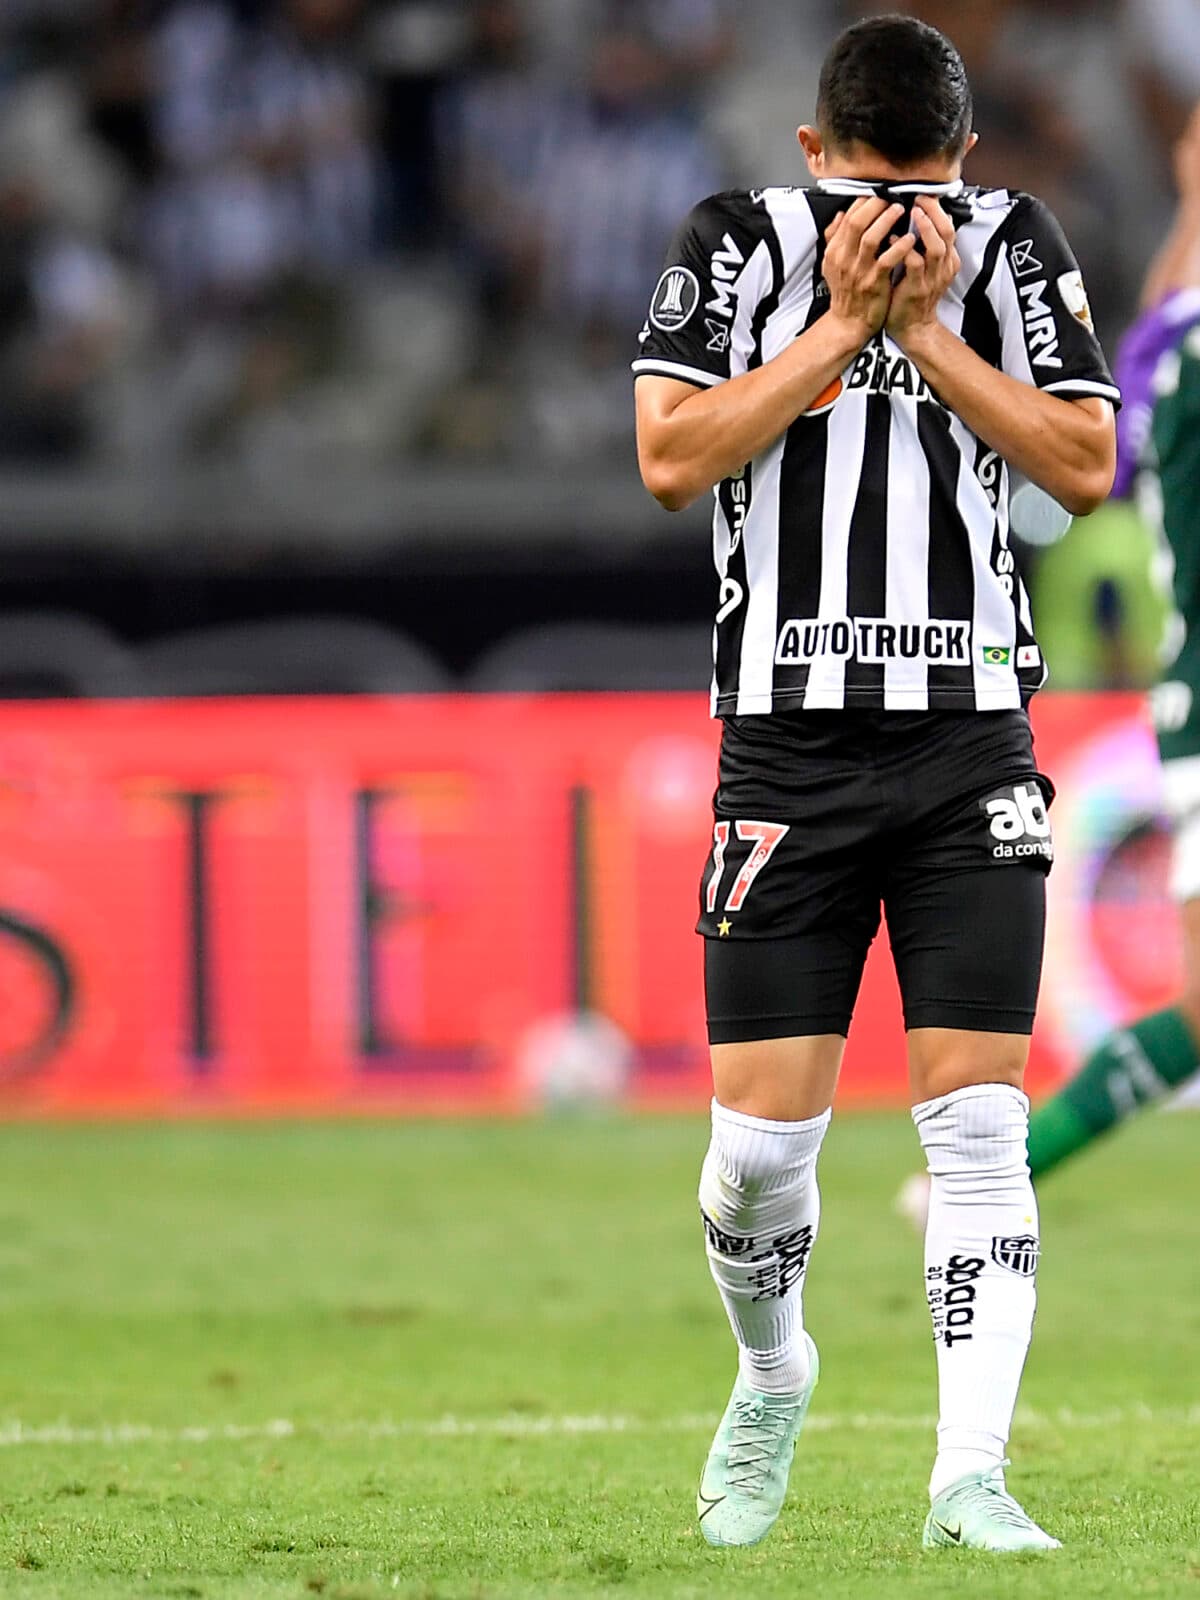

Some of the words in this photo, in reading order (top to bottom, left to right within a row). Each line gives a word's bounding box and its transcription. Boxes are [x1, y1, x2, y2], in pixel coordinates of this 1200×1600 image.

[705, 232, 744, 318] MRV
[1019, 279, 1063, 368] MRV
[986, 785, 1050, 840] ab
[993, 842, 1014, 858] da
[706, 820, 790, 913] 17
[944, 1254, 986, 1348] TODOS
